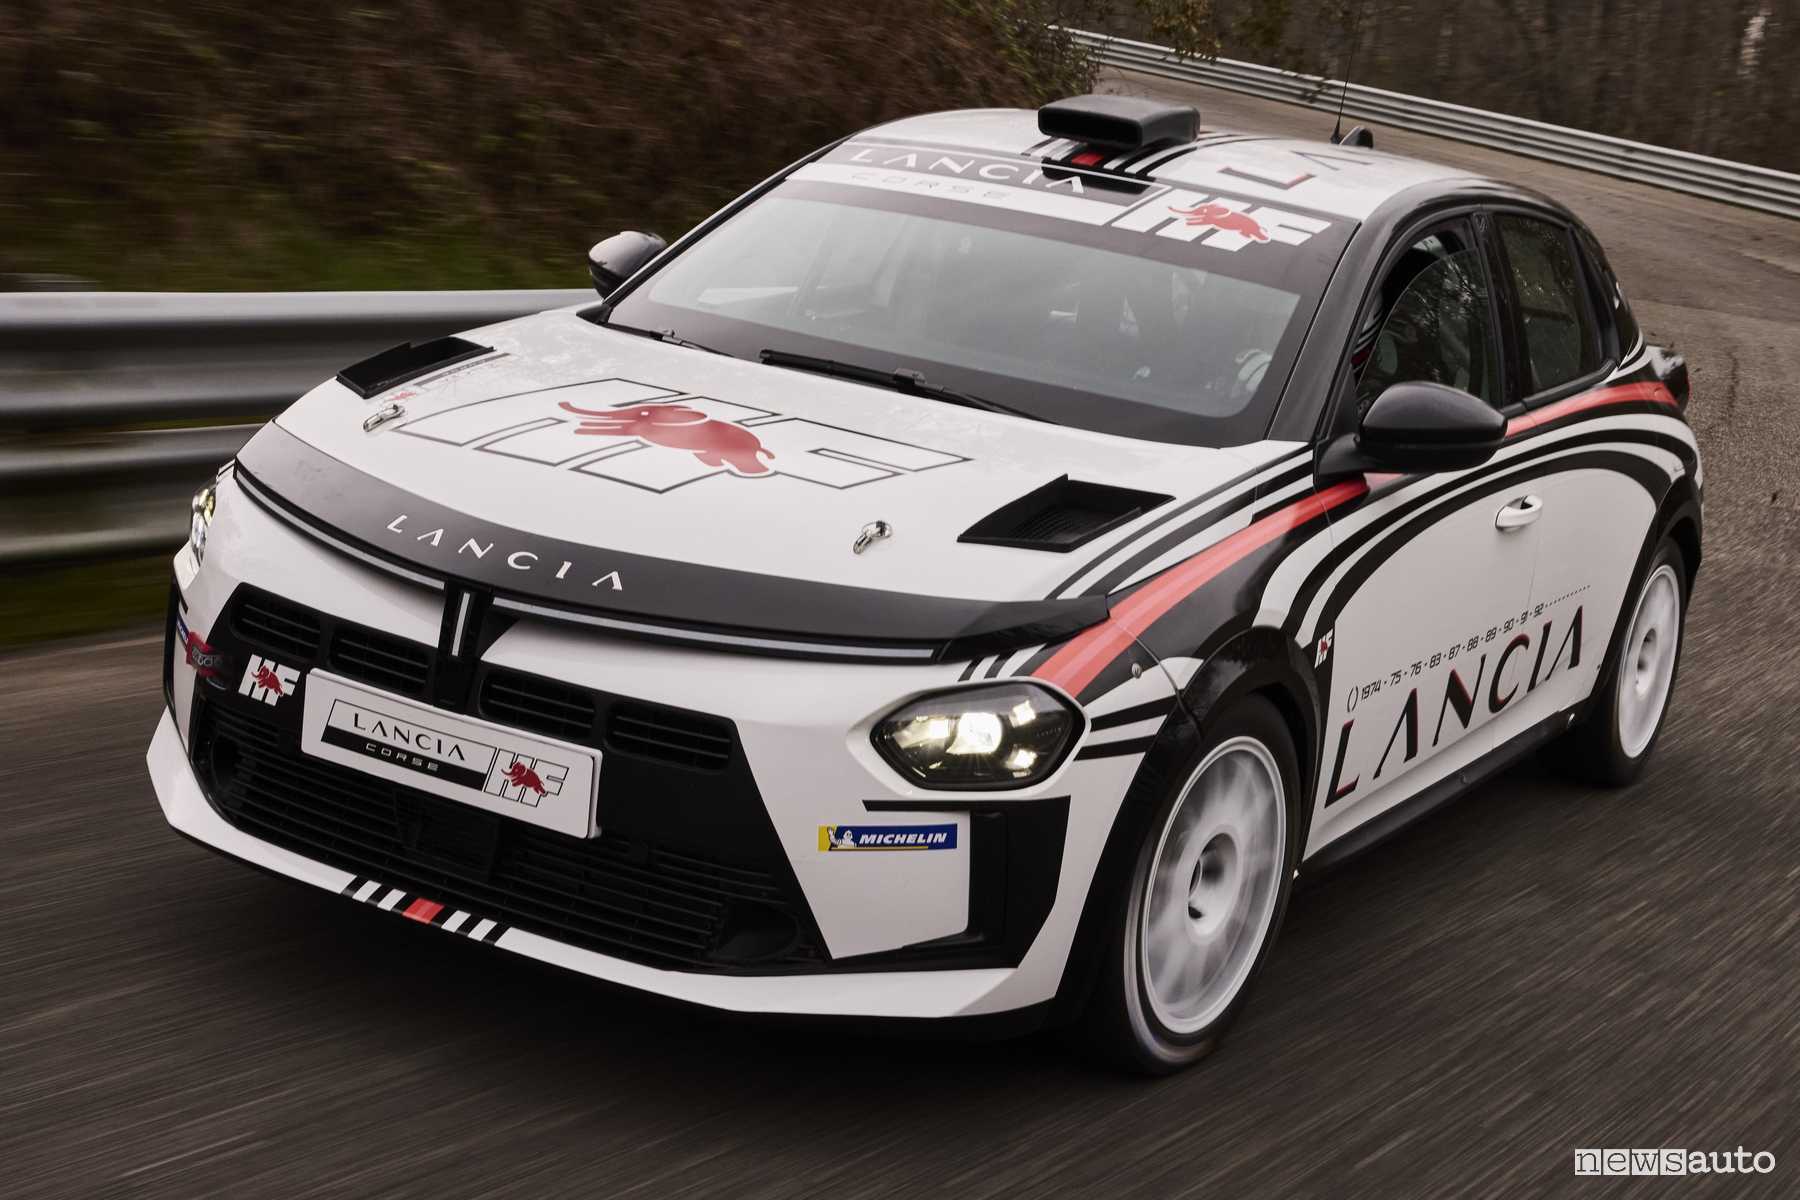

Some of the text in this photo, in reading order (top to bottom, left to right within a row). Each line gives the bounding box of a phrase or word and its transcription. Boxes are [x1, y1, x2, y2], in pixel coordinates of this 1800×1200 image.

[850, 148, 1085, 194] LANCIA
[386, 515, 624, 592] LANCIA
[1325, 605, 1584, 808] LANCIA
[353, 712, 466, 761] LANCIA
[365, 742, 439, 772] CORSE
[858, 831, 947, 845] MICHELIN
